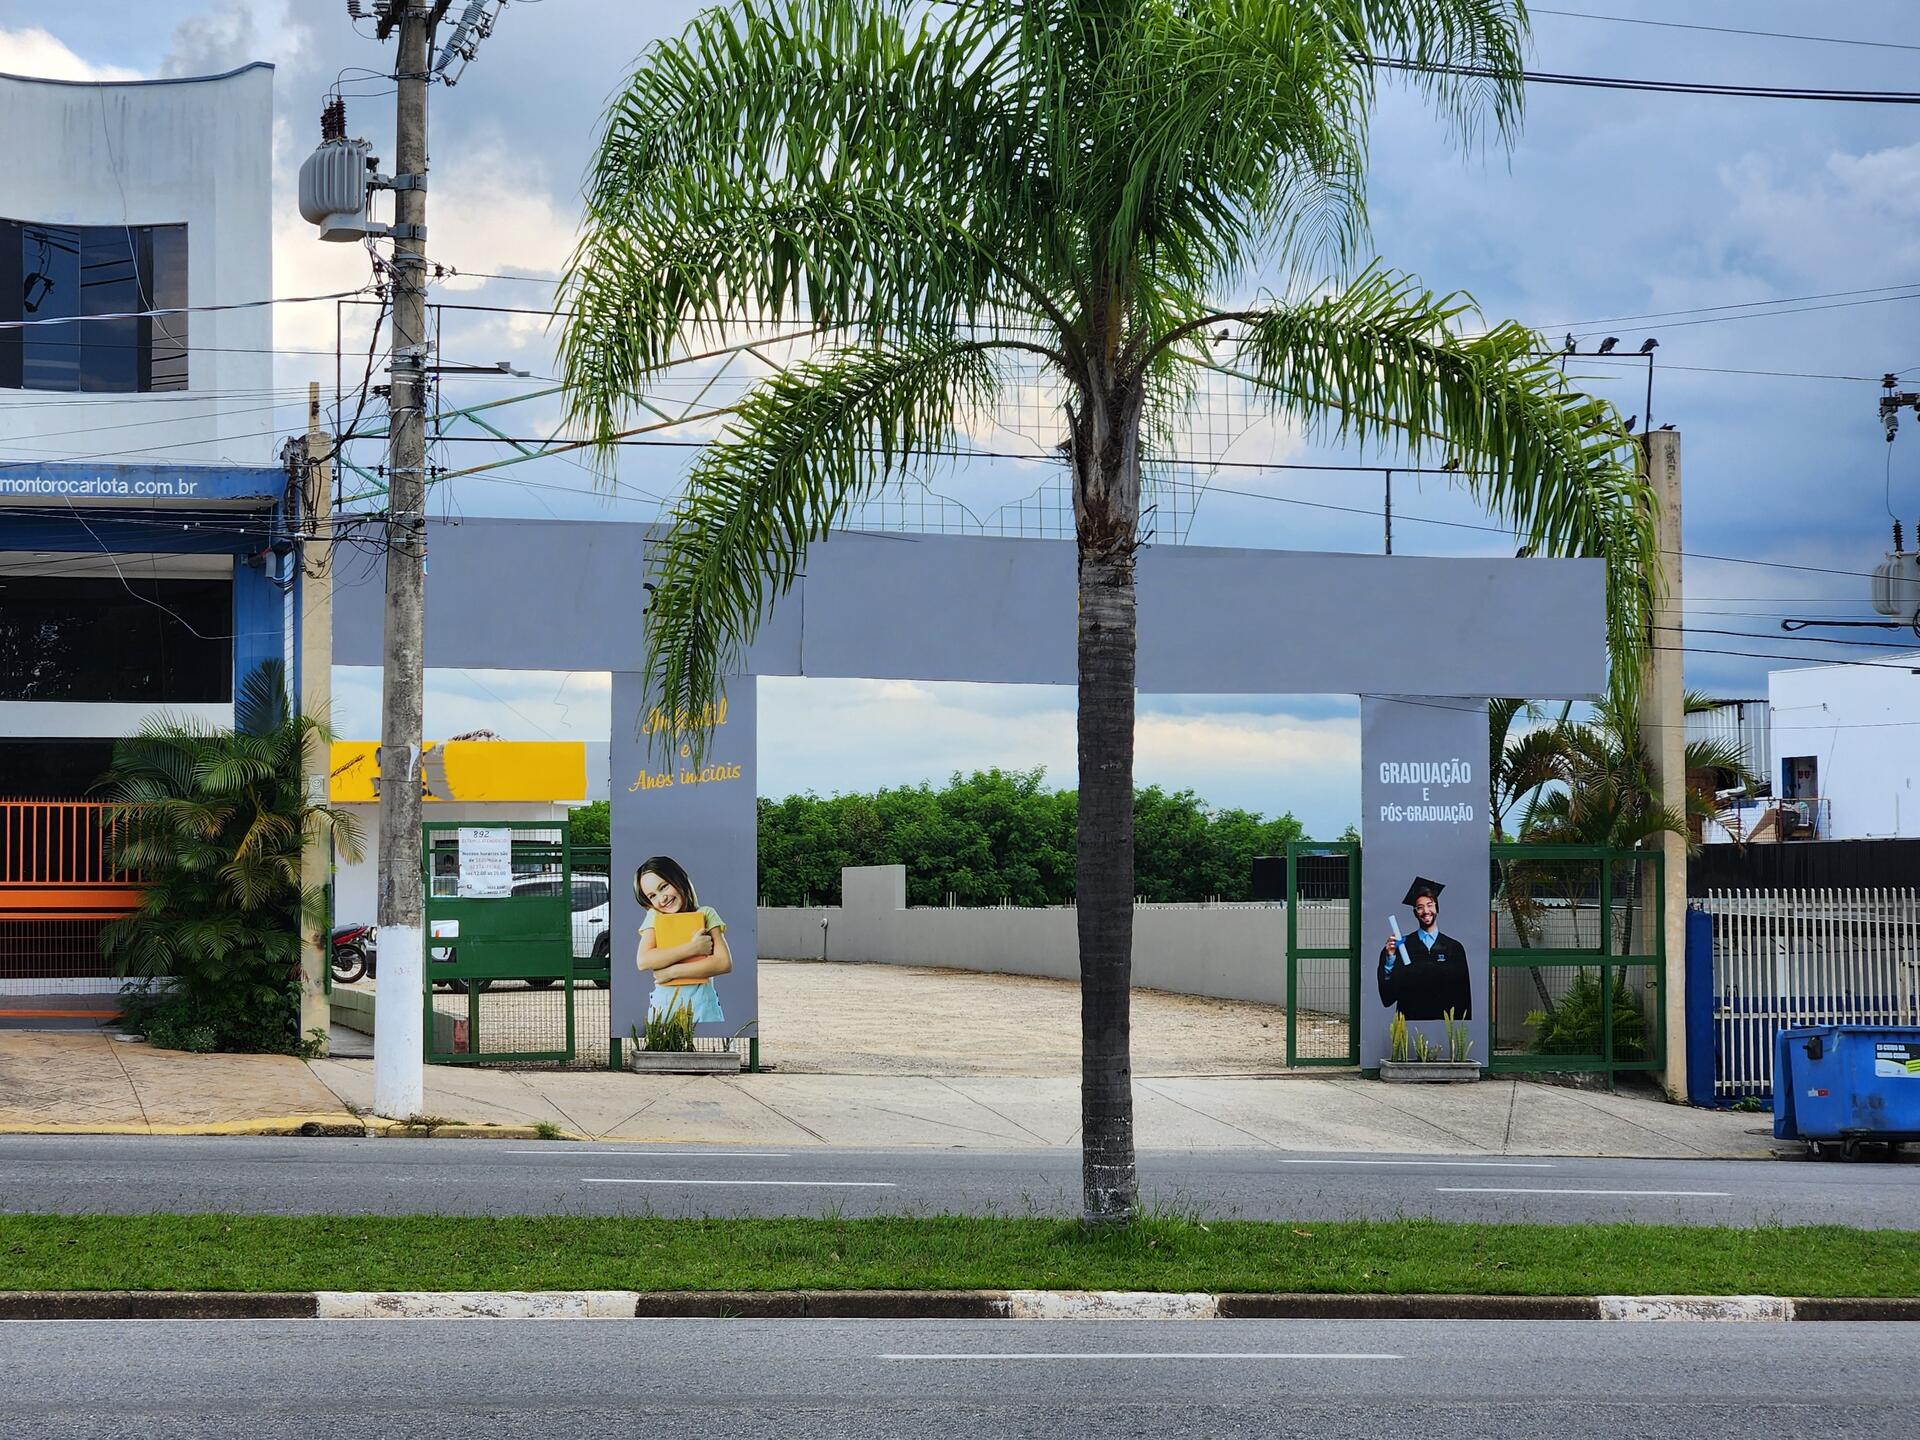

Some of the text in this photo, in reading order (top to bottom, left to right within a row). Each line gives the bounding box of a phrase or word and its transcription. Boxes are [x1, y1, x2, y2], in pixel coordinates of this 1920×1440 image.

[0, 476, 198, 495] montorocarlota.com.br
[642, 697, 728, 740] Infatil
[680, 744, 691, 758] e
[628, 768, 674, 792] Anos
[1380, 758, 1472, 787] GRADUAÇÃO
[1422, 787, 1430, 801] E
[1380, 802, 1474, 824] PÓS-GRADUAÇÃO
[473, 830, 490, 839] 892
